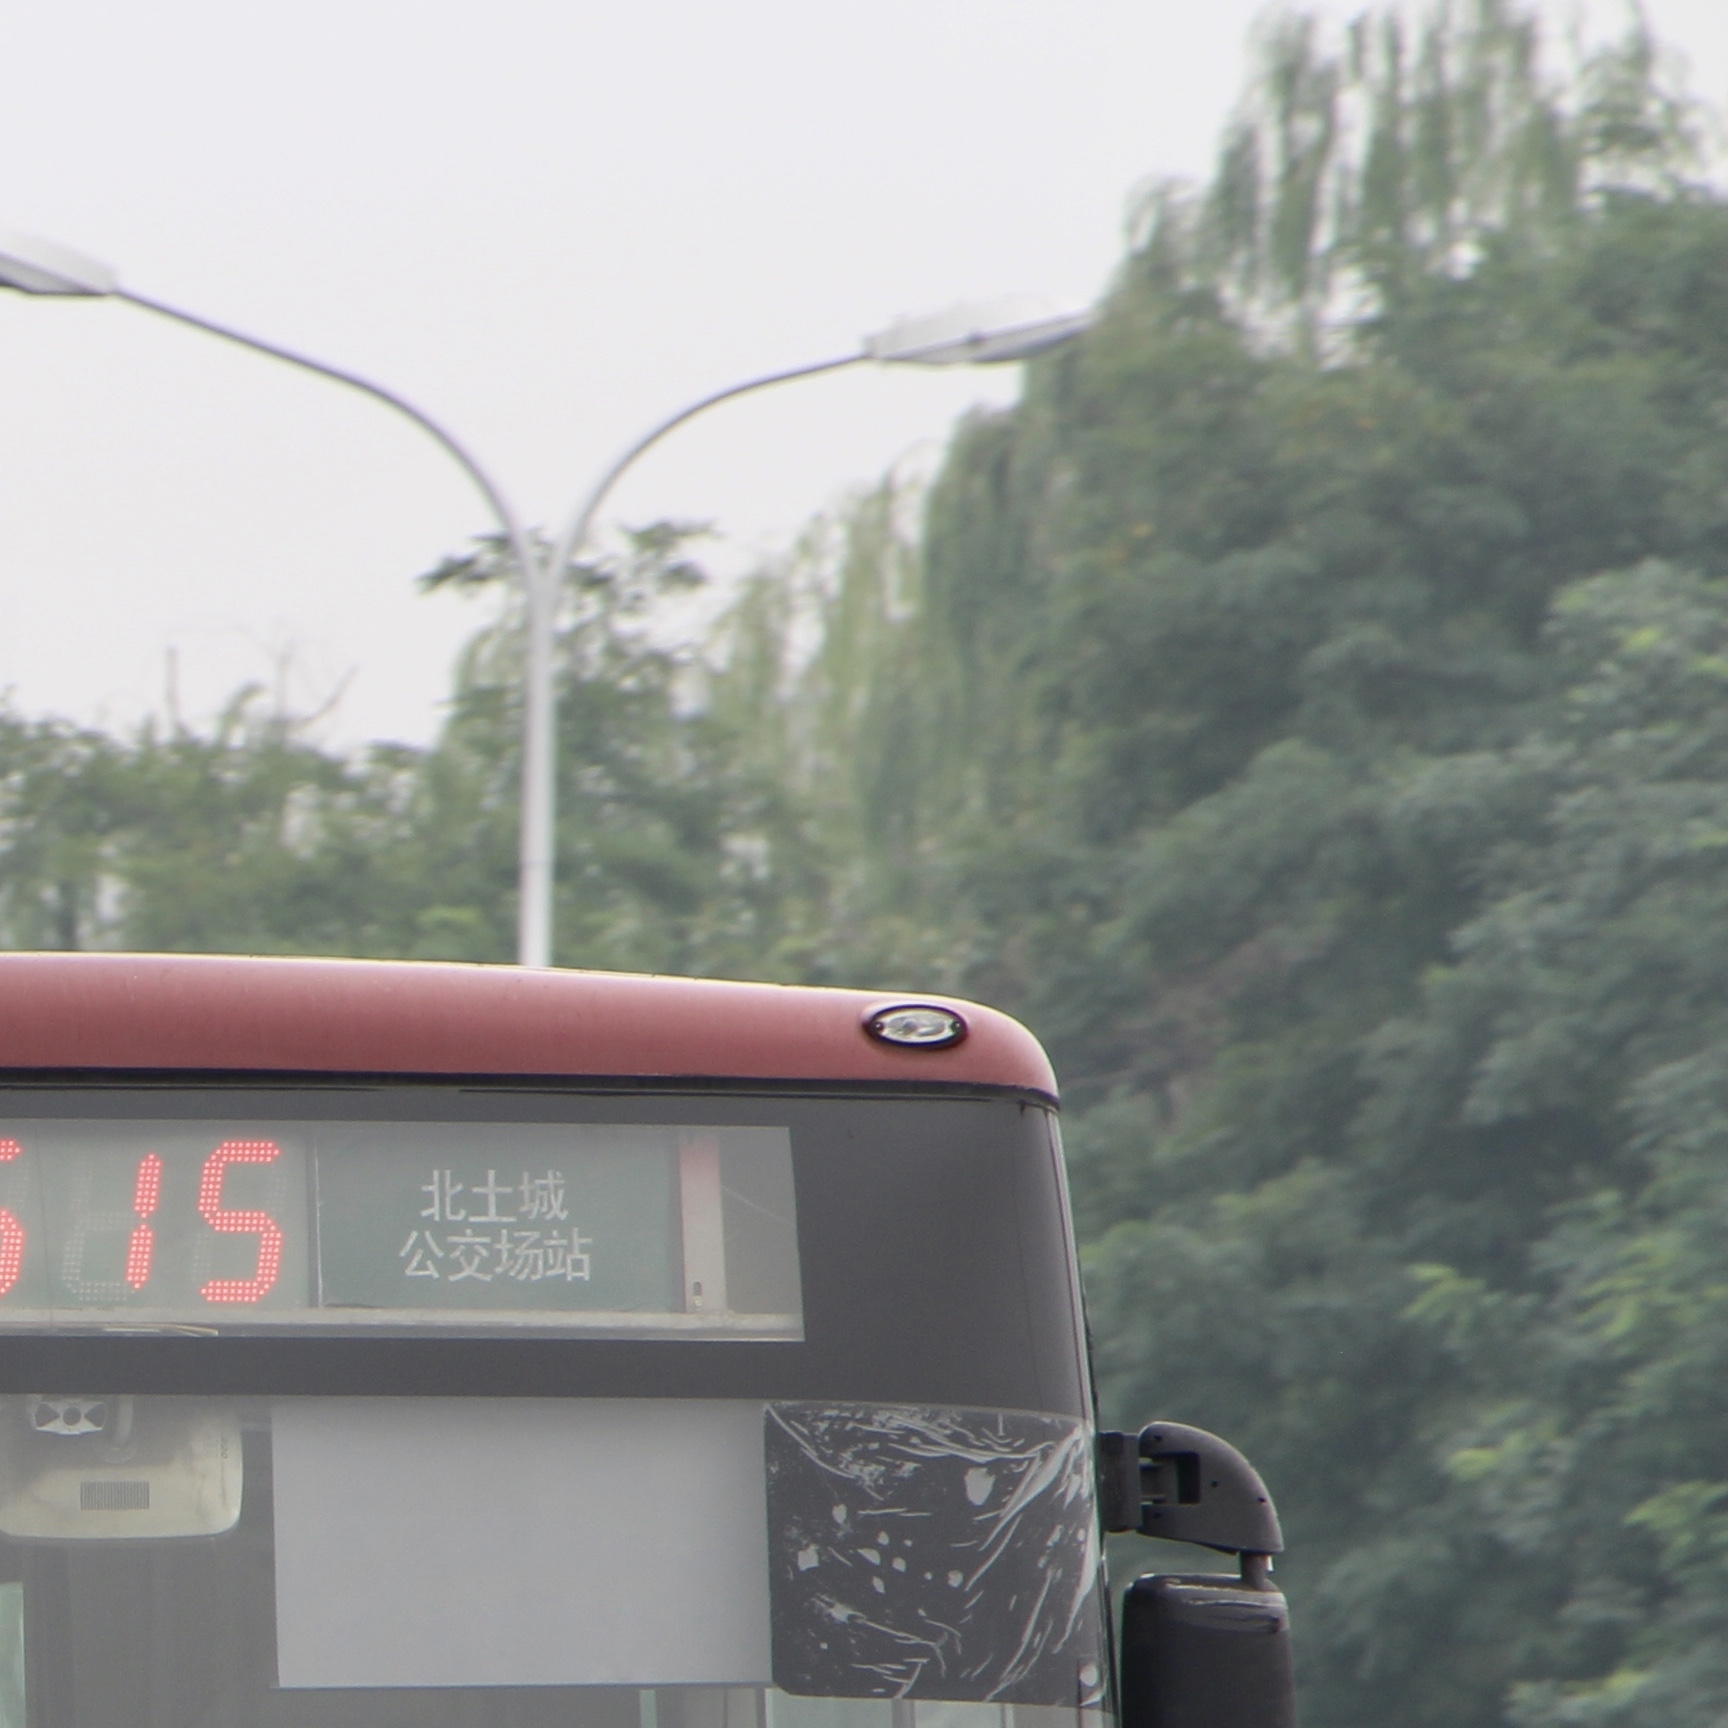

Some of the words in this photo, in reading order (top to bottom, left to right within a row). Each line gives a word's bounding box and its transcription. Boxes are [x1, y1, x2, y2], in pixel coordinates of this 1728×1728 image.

[420, 1169, 569, 1223] 北土城
[398, 1227, 593, 1282] 公交场站
